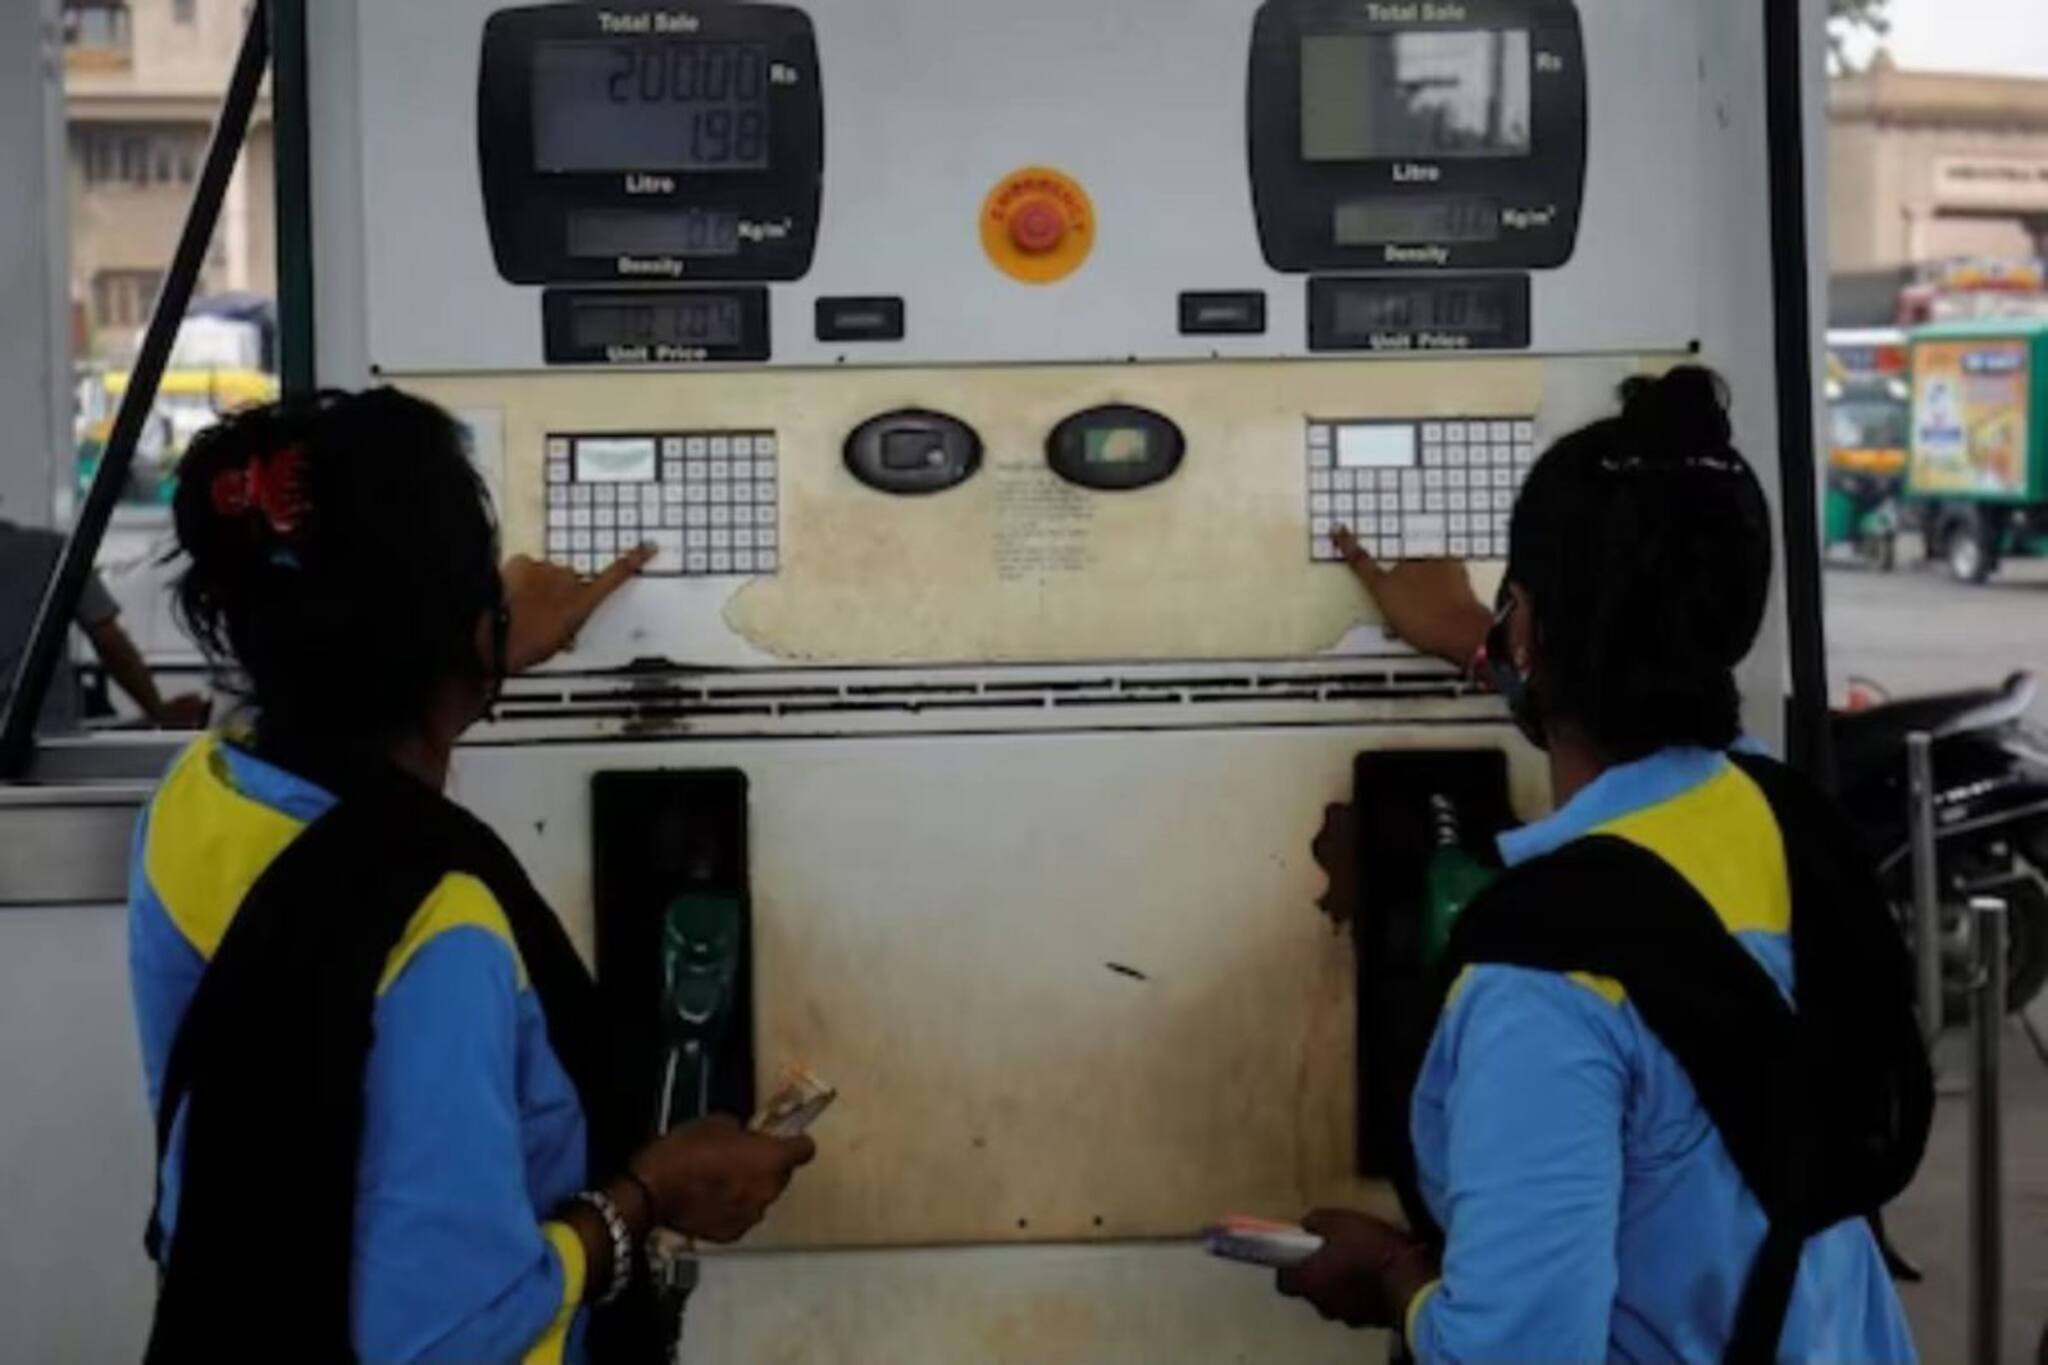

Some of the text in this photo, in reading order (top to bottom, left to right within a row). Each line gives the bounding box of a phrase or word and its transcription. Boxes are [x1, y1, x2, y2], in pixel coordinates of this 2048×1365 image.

[1365, 3, 1466, 21] Total Sale
[597, 12, 700, 32] Total Sale
[1535, 52, 1563, 71] Rs
[770, 63, 798, 83] Rs
[1392, 163, 1441, 182] Litre
[625, 174, 675, 194] Litre
[1384, 245, 1448, 265] Density
[617, 256, 684, 277] Density
[1369, 332, 1469, 348] Unit Price
[605, 345, 708, 362] Unit Price
